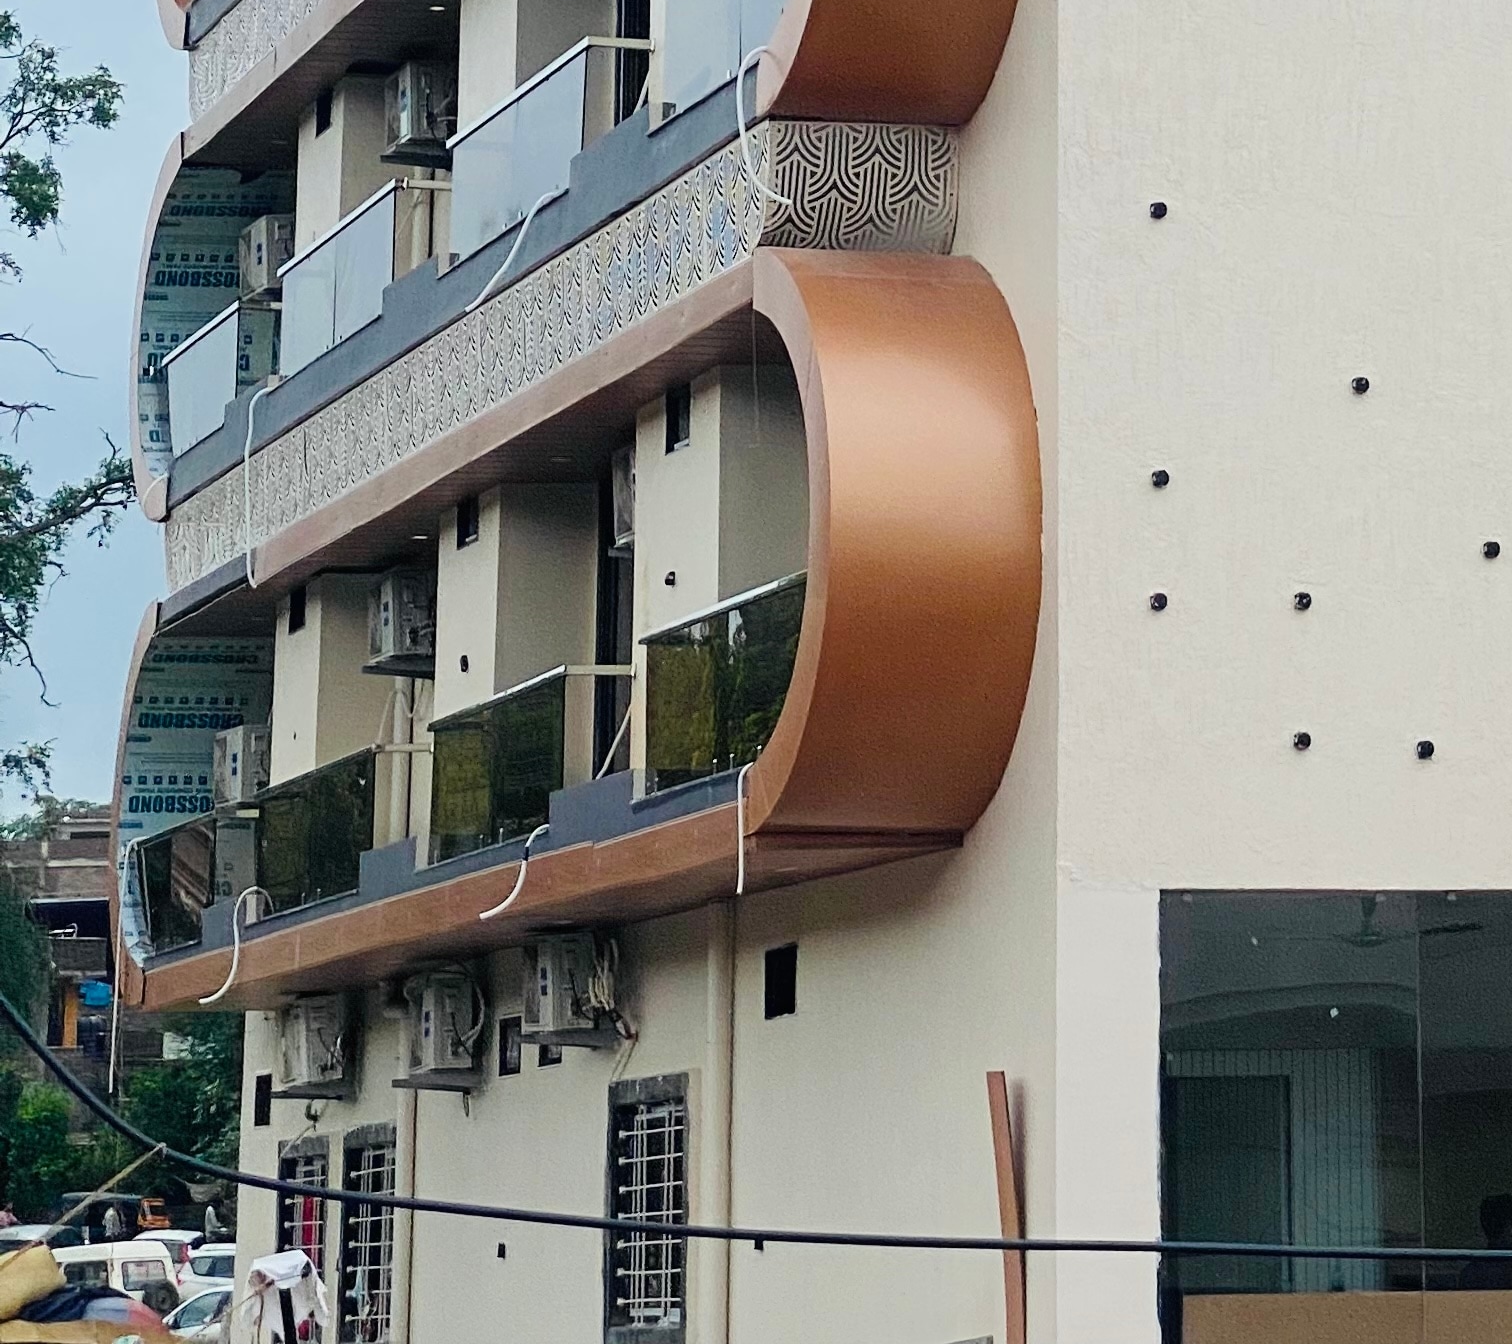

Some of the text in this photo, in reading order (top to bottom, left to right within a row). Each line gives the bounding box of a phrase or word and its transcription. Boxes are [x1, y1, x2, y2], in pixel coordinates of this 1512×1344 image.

[154, 270, 240, 289] OSSBOND
[138, 713, 244, 730] CROSSBOND
[128, 795, 215, 814] OSSBOND
